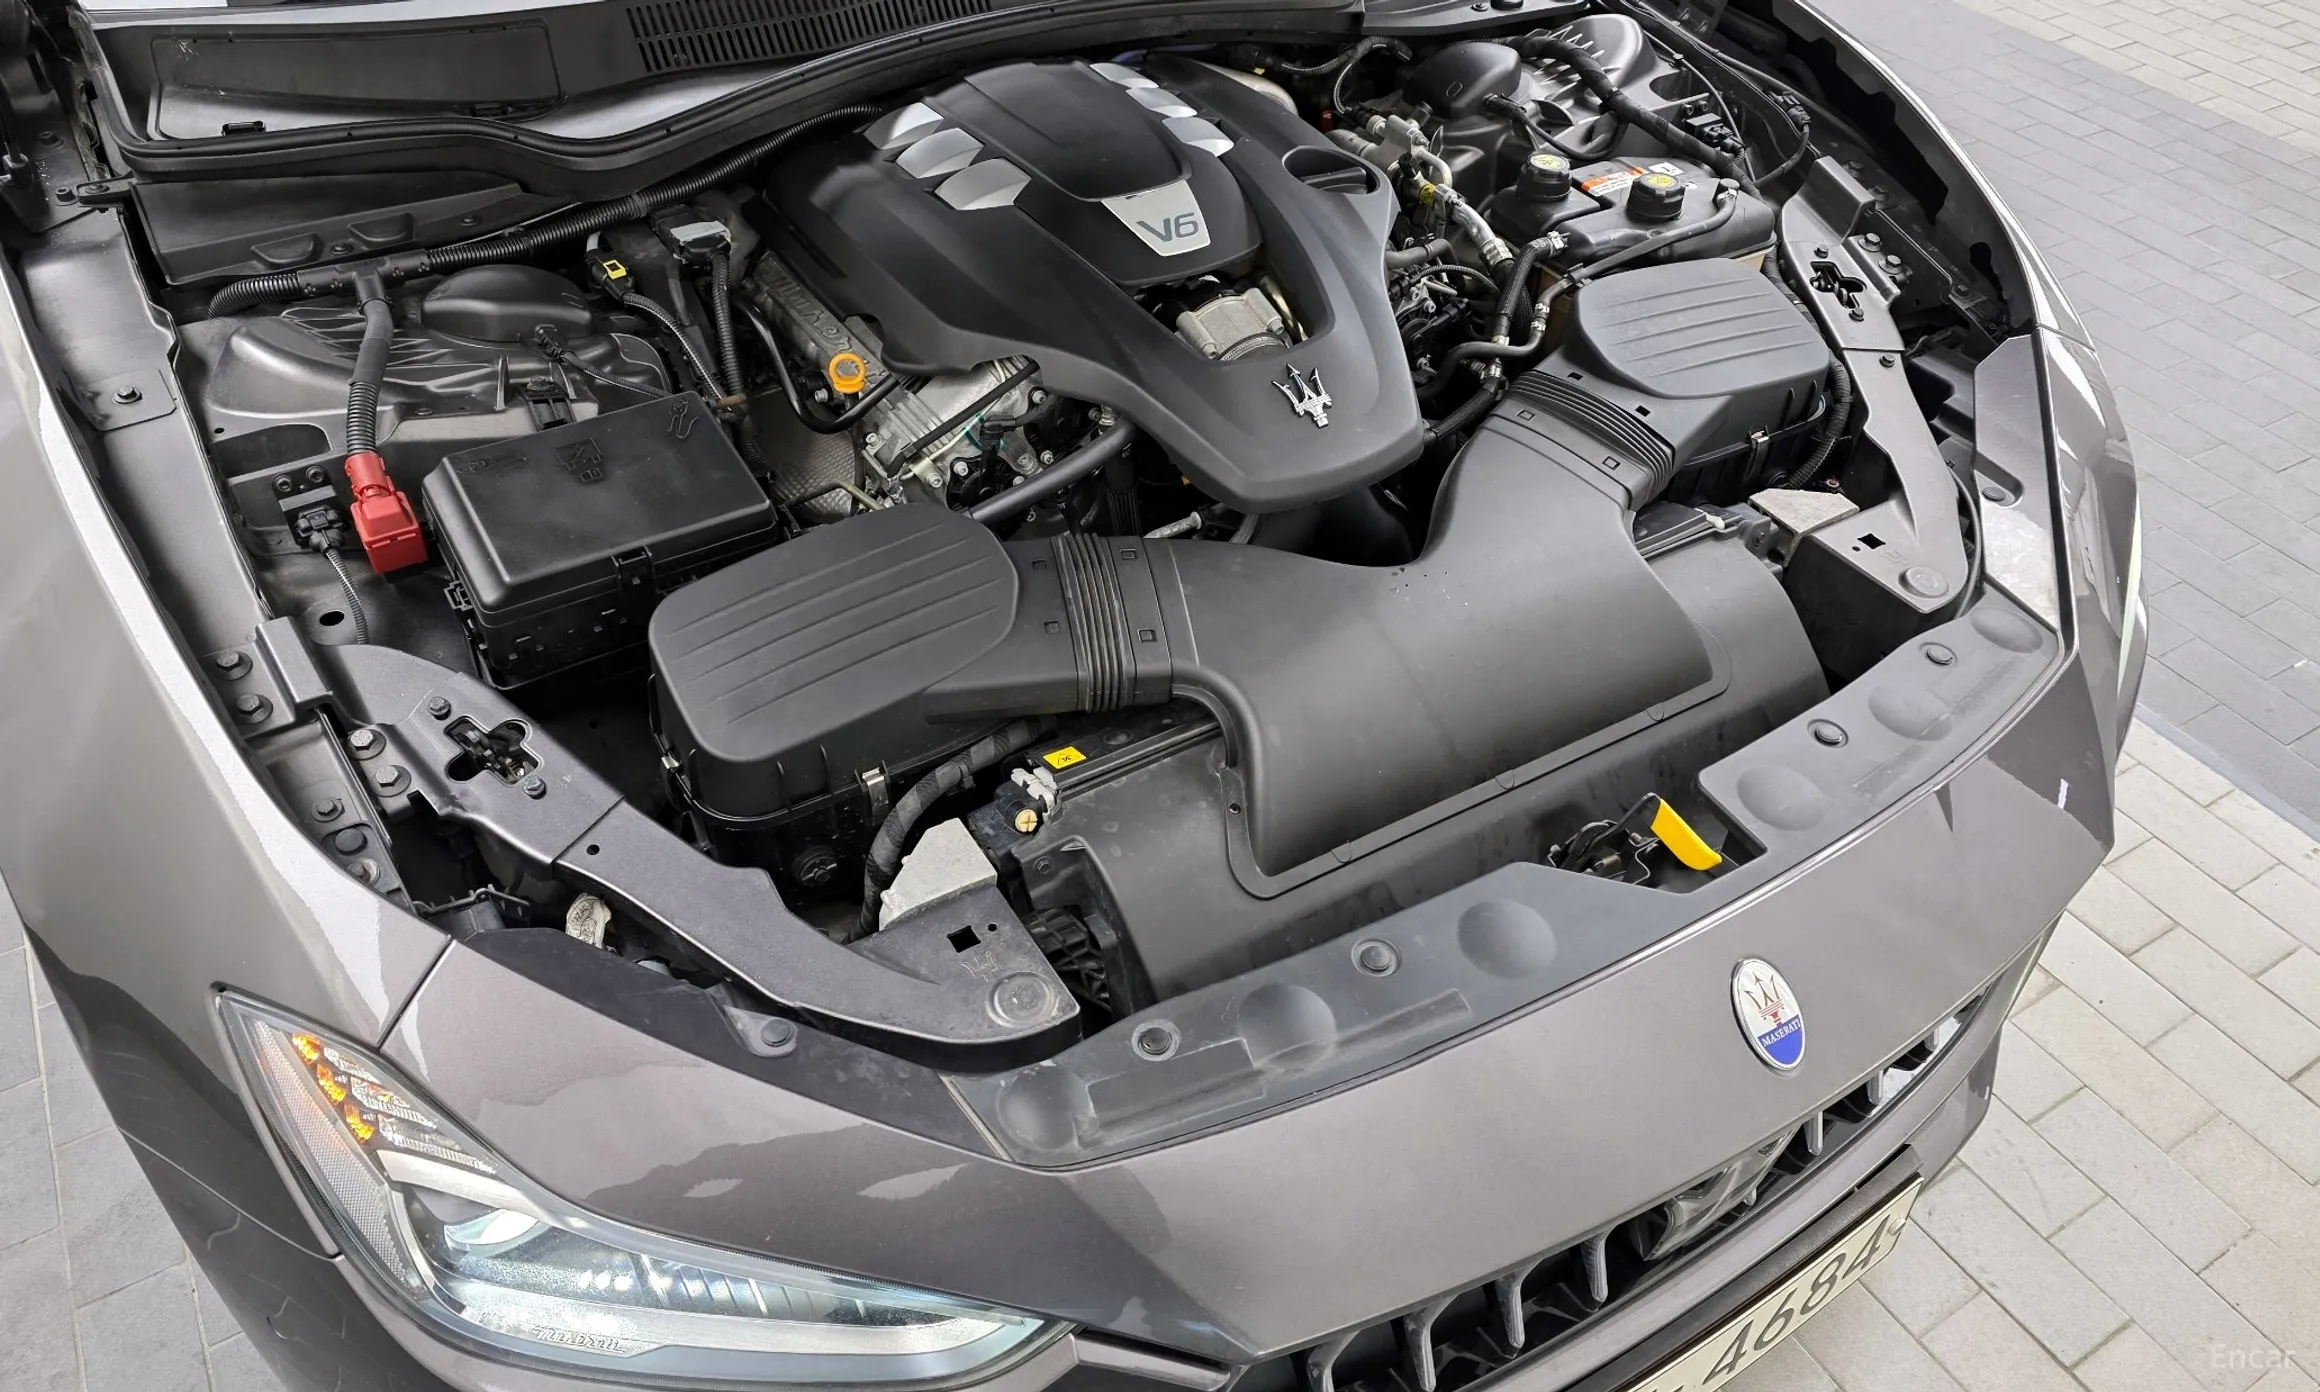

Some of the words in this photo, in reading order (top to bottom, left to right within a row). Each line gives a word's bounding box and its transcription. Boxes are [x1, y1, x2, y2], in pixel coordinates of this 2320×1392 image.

[1136, 212, 1199, 242] V6
[1762, 1018, 1802, 1047] MASERATI
[1702, 1214, 1891, 1386] 4684
